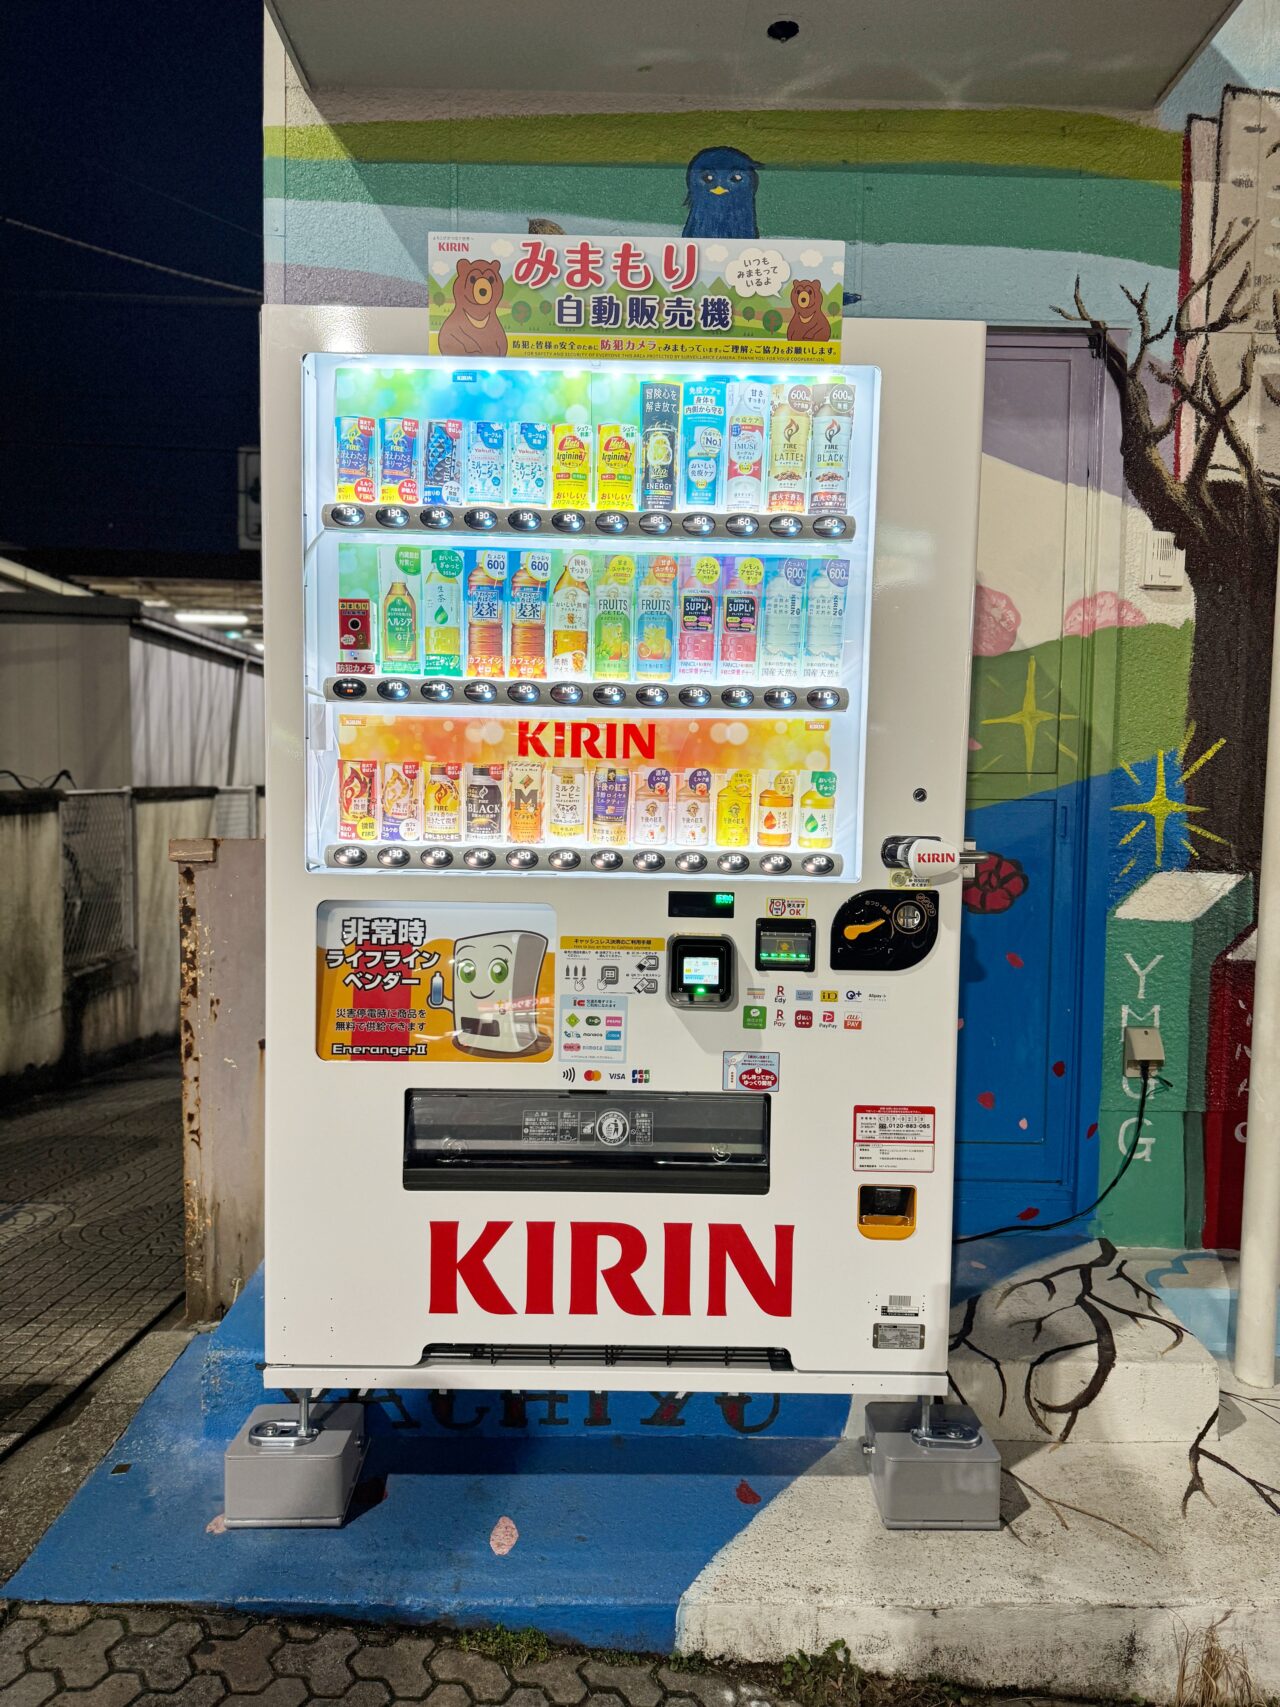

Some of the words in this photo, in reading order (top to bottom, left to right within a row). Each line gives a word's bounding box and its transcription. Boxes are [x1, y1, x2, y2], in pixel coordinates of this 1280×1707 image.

[438, 242, 469, 252] KIRIN
[515, 241, 698, 290] みまもり
[743, 257, 769, 267] いつも
[737, 266, 778, 279] みまもって
[746, 277, 772, 288] いるよ
[558, 295, 731, 329] 自動販売機
[645, 388, 677, 400] 冒険心を
[686, 406, 723, 415] 内側から守る
[817, 454, 844, 462] BLACK
[646, 482, 672, 490] ENERGY
[432, 510, 445, 518] 120
[650, 516, 663, 524] 180
[738, 518, 750, 526] 160
[487, 560, 505, 570] 600
[531, 561, 549, 570] 600
[474, 603, 496, 616] 麦茶
[599, 600, 628, 610] FRUITS
[642, 600, 671, 610] FRUITS
[517, 604, 540, 617] 麦茶
[388, 618, 412, 626] ヘルシア
[337, 664, 374, 673] 防犯カメラ
[562, 686, 575, 694] 140
[733, 690, 745, 698] 130
[818, 691, 831, 699] 110
[518, 721, 656, 759] KIRIN
[597, 783, 626, 792] 午後の紅茶
[515, 789, 538, 810] M
[468, 804, 500, 813] BLACK
[346, 849, 358, 857] 120
[517, 852, 530, 860] 120
[560, 852, 573, 860] 130
[917, 853, 955, 863] KIRIN
[813, 857, 826, 865] 120
[342, 917, 426, 946] 非常時
[326, 950, 440, 969] ライフライン
[343, 971, 421, 991] ベンダー
[777, 986, 784, 995] R
[336, 1008, 426, 1019] 災害停電時に商品を
[777, 1009, 783, 1018] R
[336, 1021, 426, 1032] 無料で供給できます
[428, 1221, 795, 1317] KIRIN
